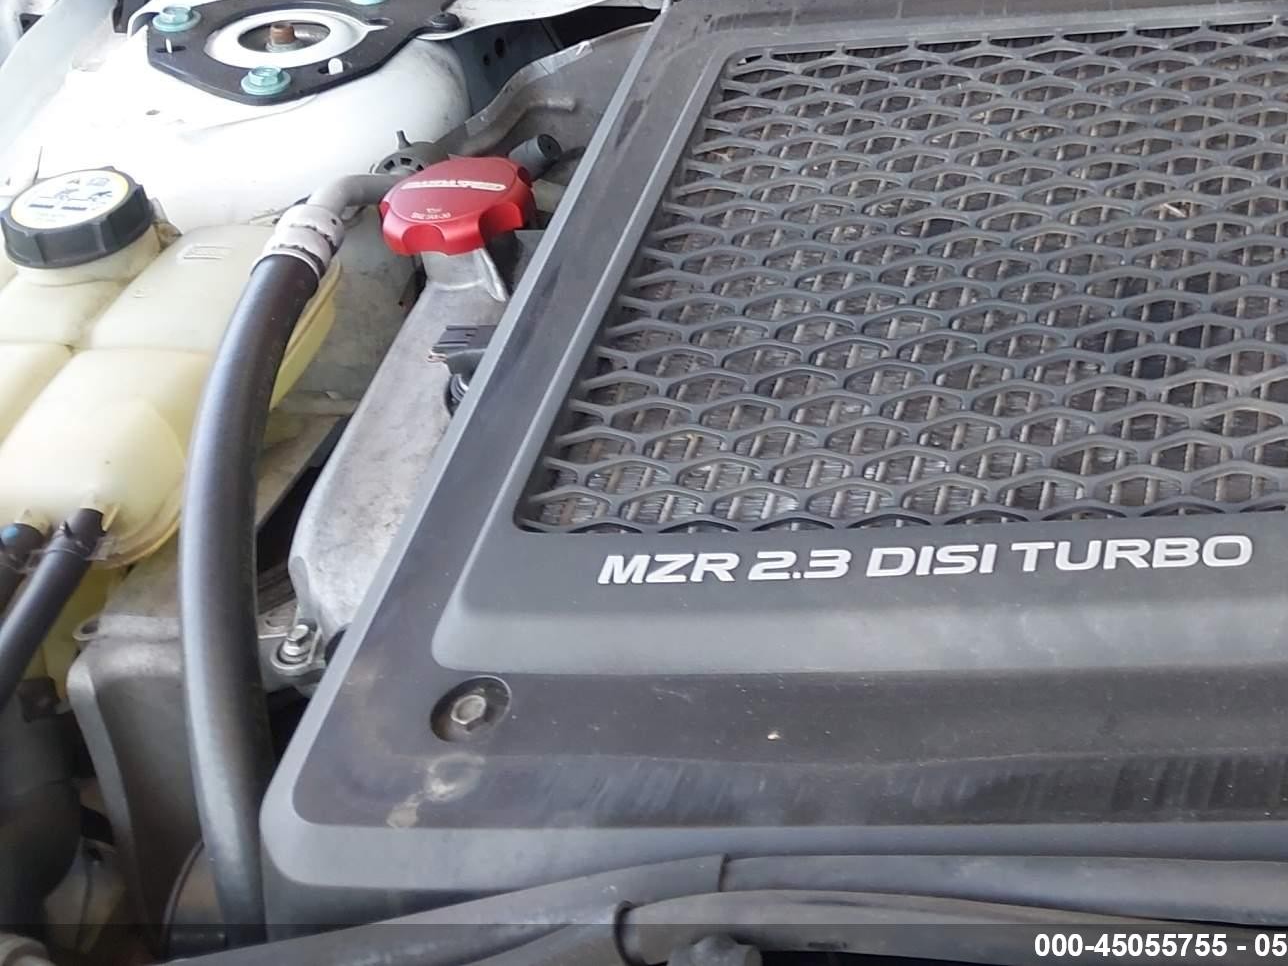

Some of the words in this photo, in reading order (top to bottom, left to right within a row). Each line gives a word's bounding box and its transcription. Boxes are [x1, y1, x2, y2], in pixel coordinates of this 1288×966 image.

[597, 553, 738, 585] MZR
[747, 549, 851, 582] 2.3
[865, 543, 998, 578] DISI
[1011, 535, 1253, 572] TURBO
